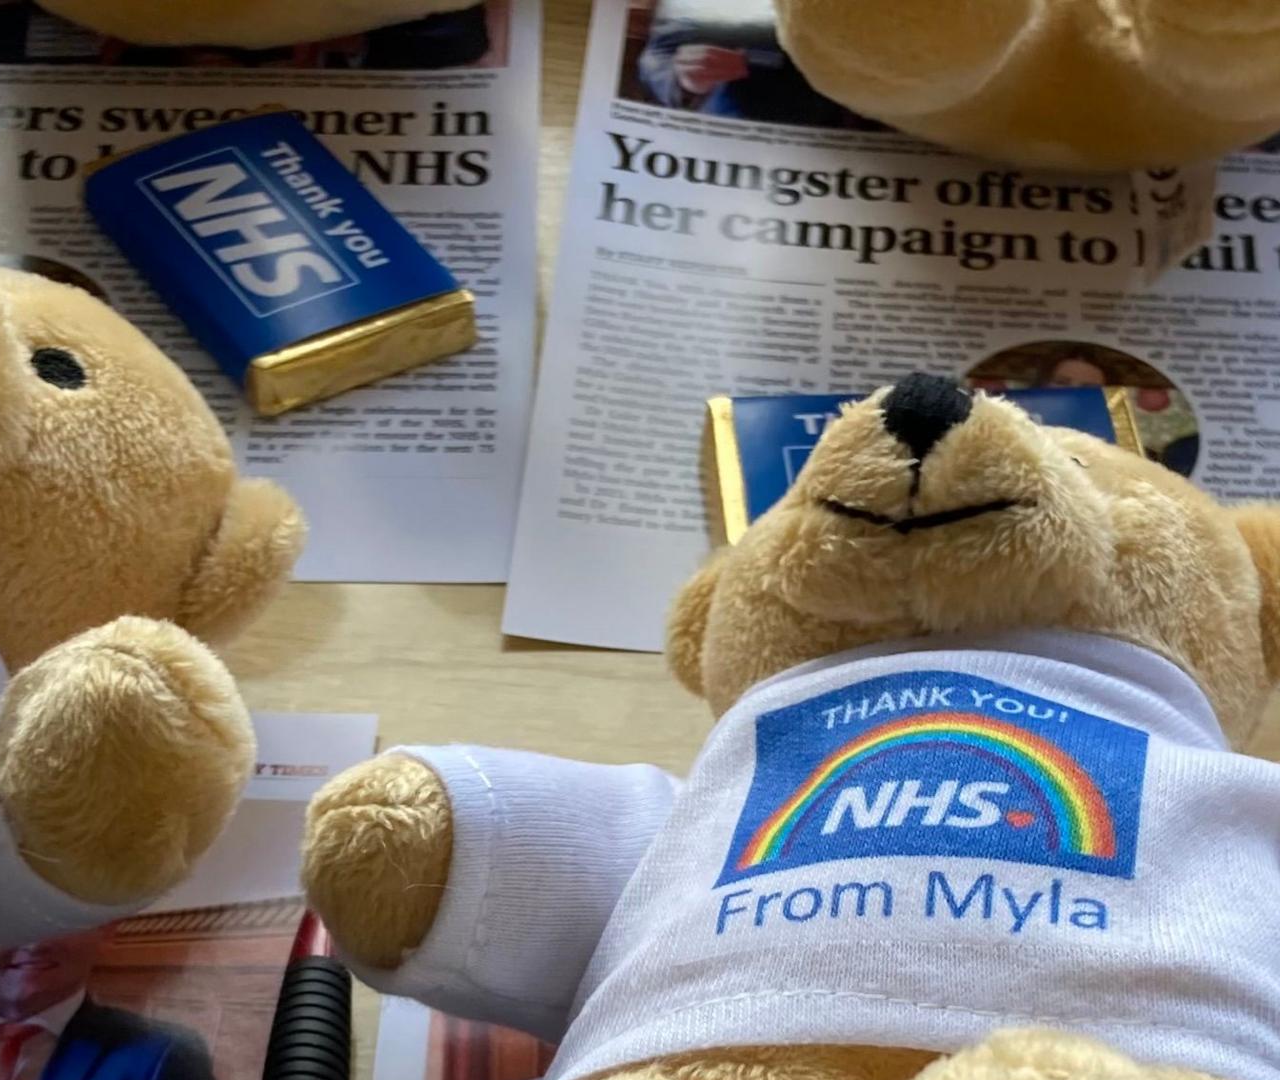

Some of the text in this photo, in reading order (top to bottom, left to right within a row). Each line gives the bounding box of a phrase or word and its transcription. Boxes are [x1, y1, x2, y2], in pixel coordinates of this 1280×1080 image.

[431, 102, 492, 136] in
[18, 149, 77, 181] to
[353, 150, 492, 186] NHS
[607, 130, 919, 206] Youngster
[935, 169, 1113, 214] offers
[150, 162, 345, 298] NHS
[259, 141, 390, 270] Thank you
[597, 182, 703, 234] her
[721, 207, 1041, 270] campaign
[1058, 231, 1118, 265] to
[821, 686, 1070, 730] THANK YOU!
[821, 779, 1009, 836] NHS
[716, 870, 1108, 935] From Myla
